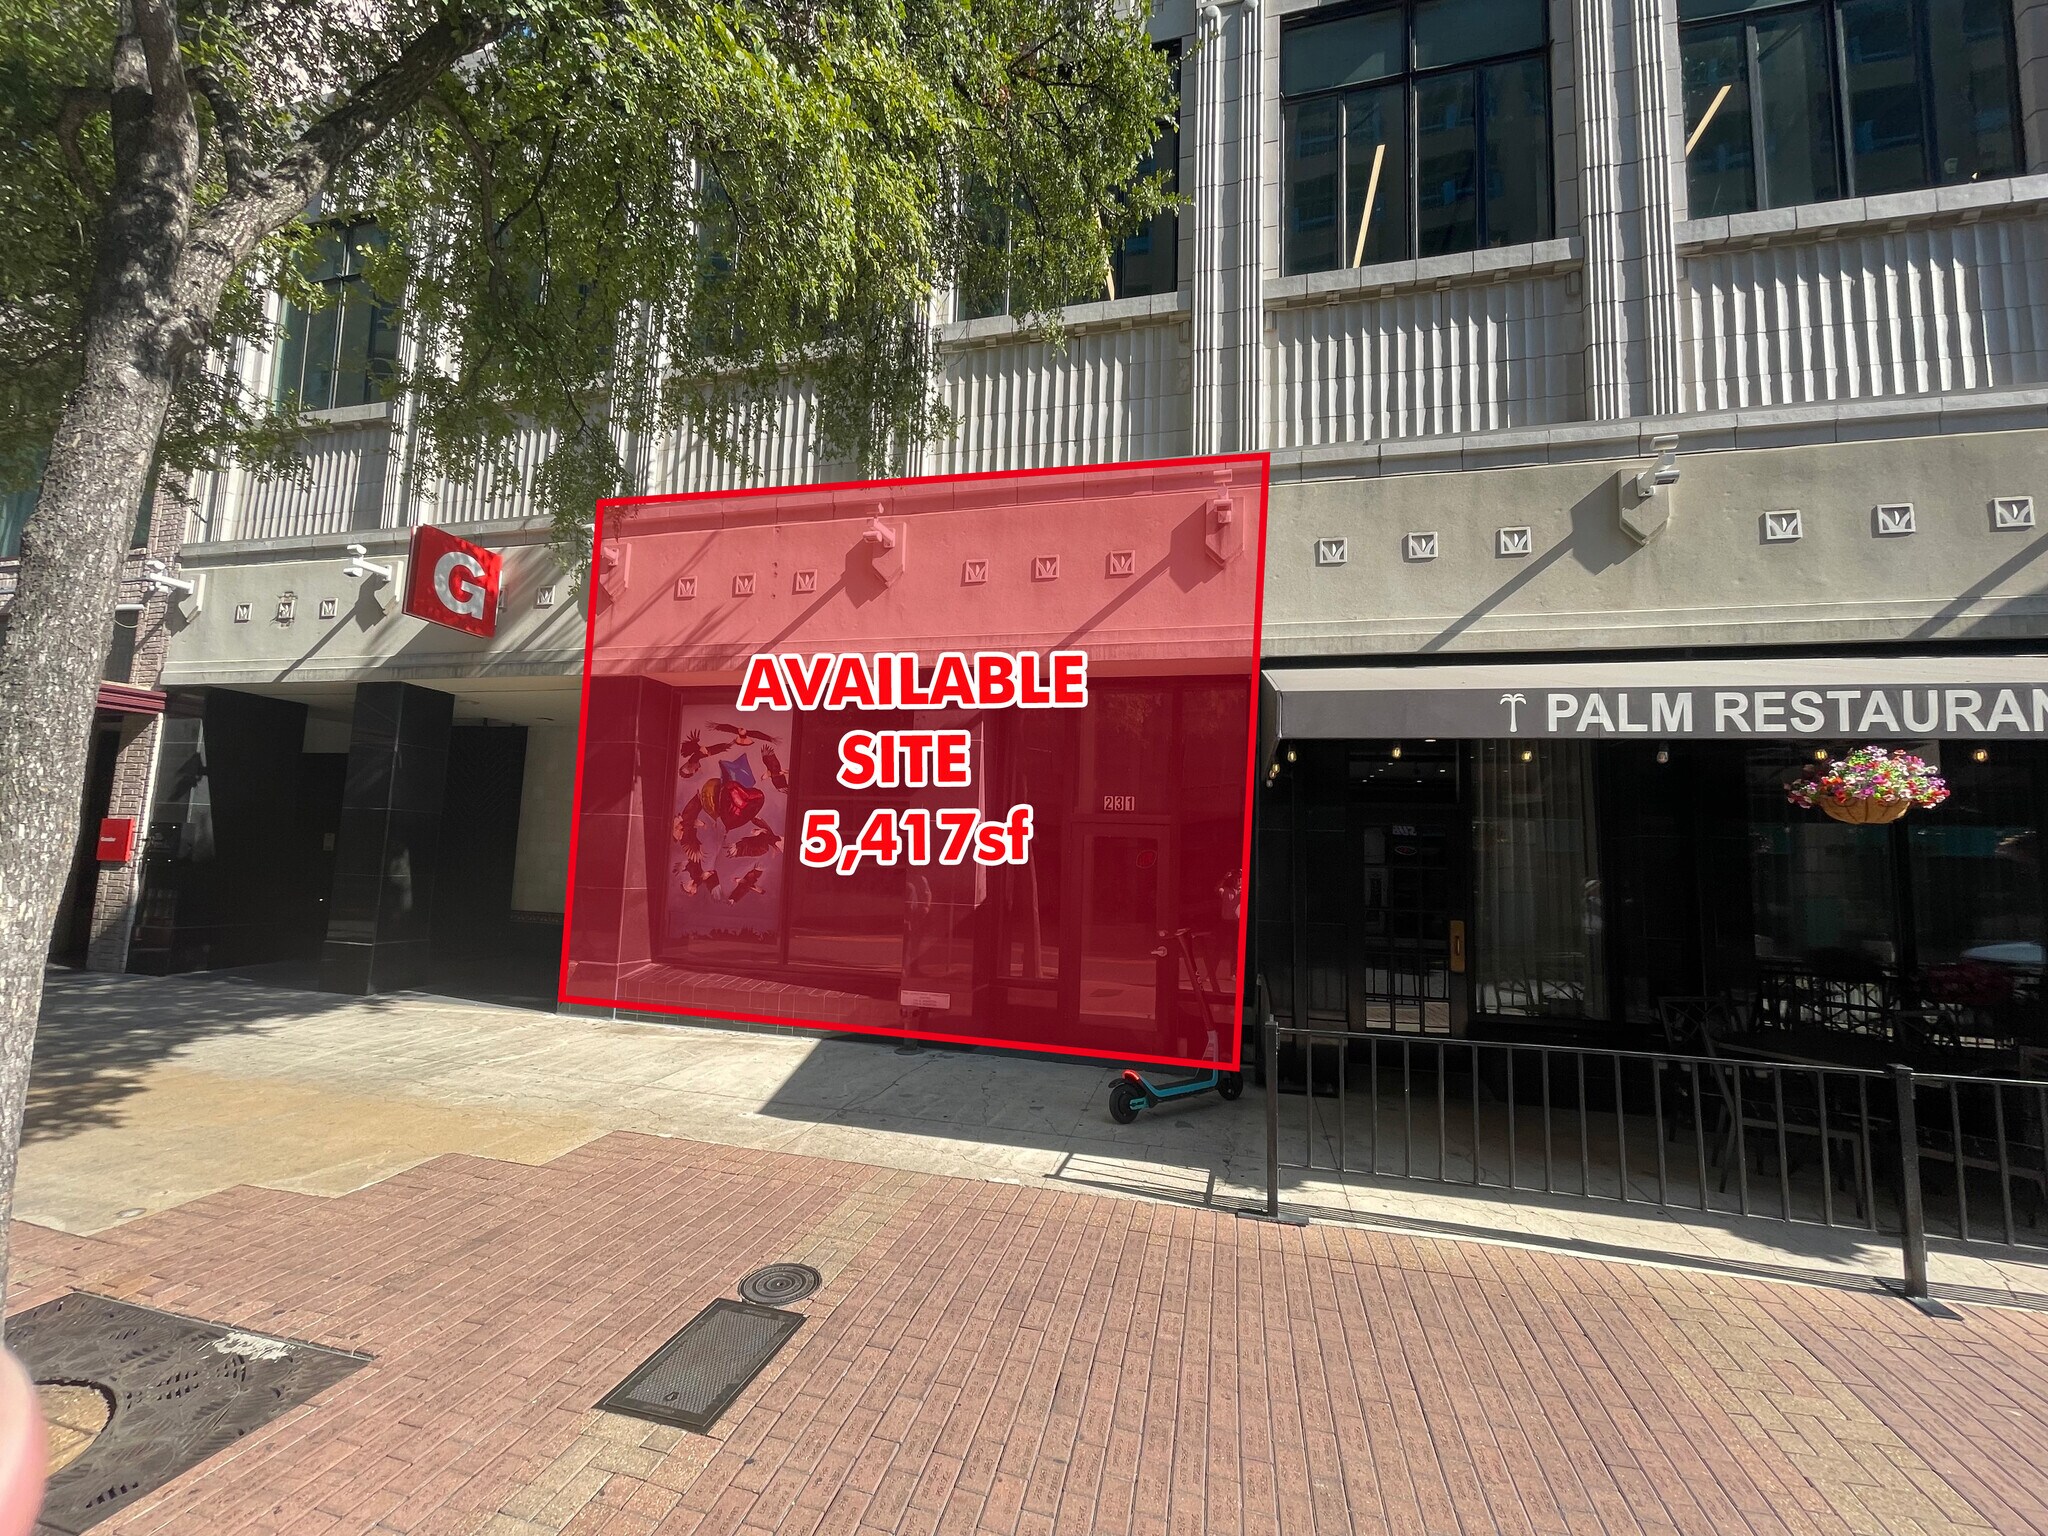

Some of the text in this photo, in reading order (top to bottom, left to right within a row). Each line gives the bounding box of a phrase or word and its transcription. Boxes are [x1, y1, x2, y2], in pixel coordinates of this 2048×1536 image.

[434, 551, 486, 620] G
[1547, 692, 1694, 732] PALM
[1104, 796, 1134, 811] 231
